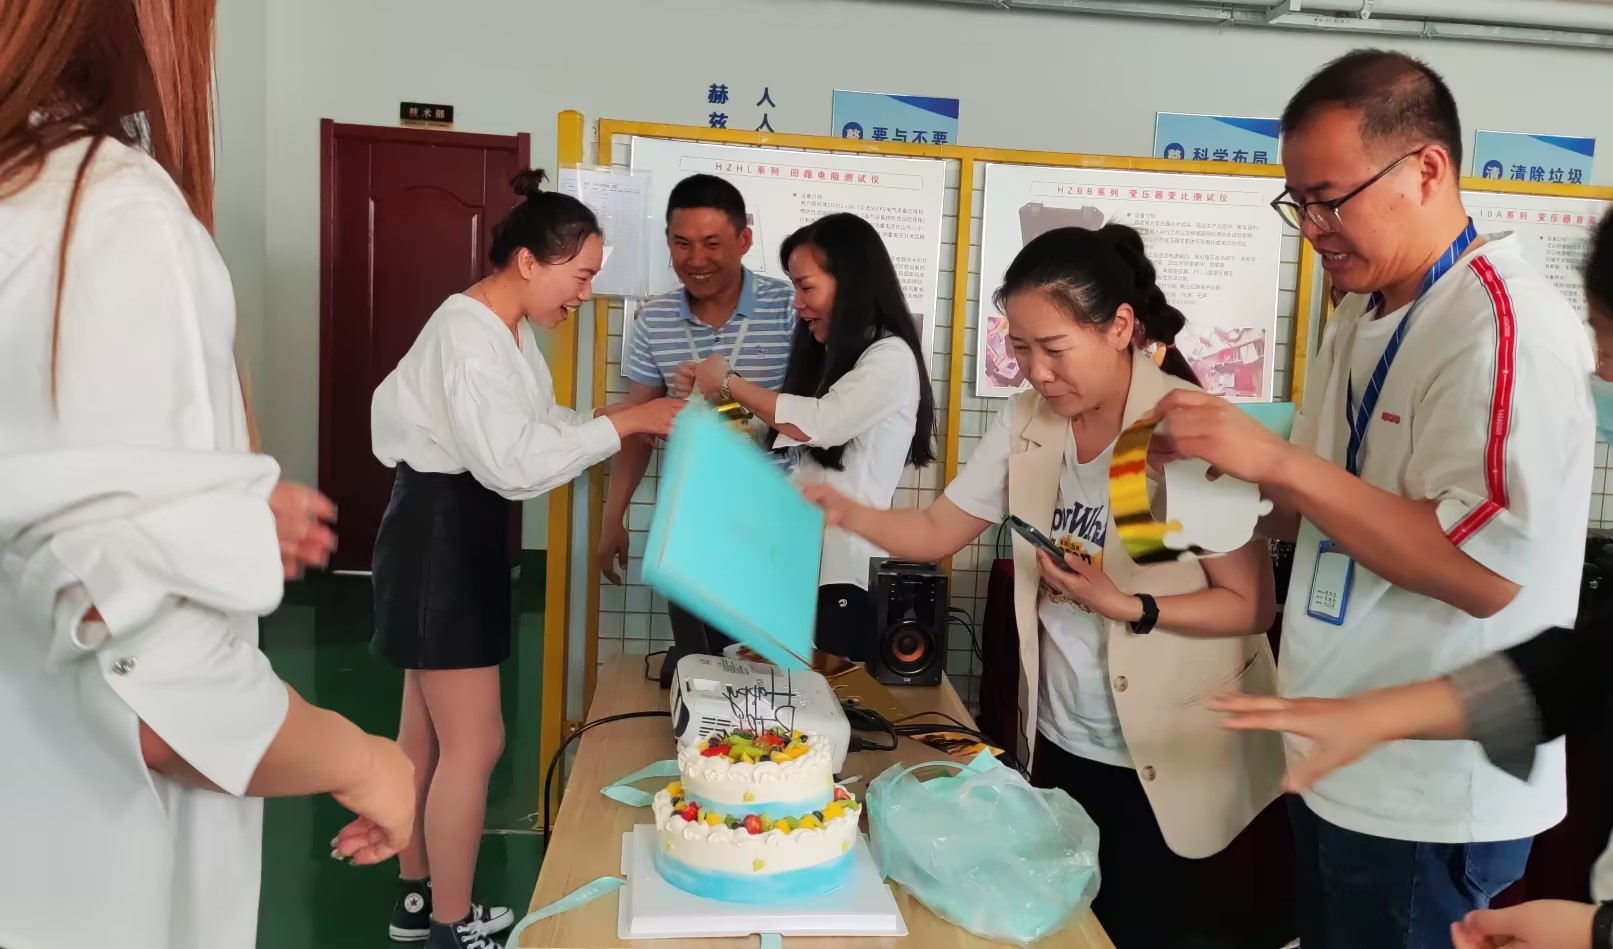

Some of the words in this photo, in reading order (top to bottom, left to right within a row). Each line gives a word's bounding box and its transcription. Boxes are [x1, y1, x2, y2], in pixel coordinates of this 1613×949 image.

[871, 126, 948, 145] 要与不要
[1192, 147, 1269, 164] 科学布局
[790, 168, 880, 184] 回路电阻测试仪
[1510, 164, 1584, 184] 清除垃圾
[1129, 189, 1228, 203] 变压器变比测试仪
